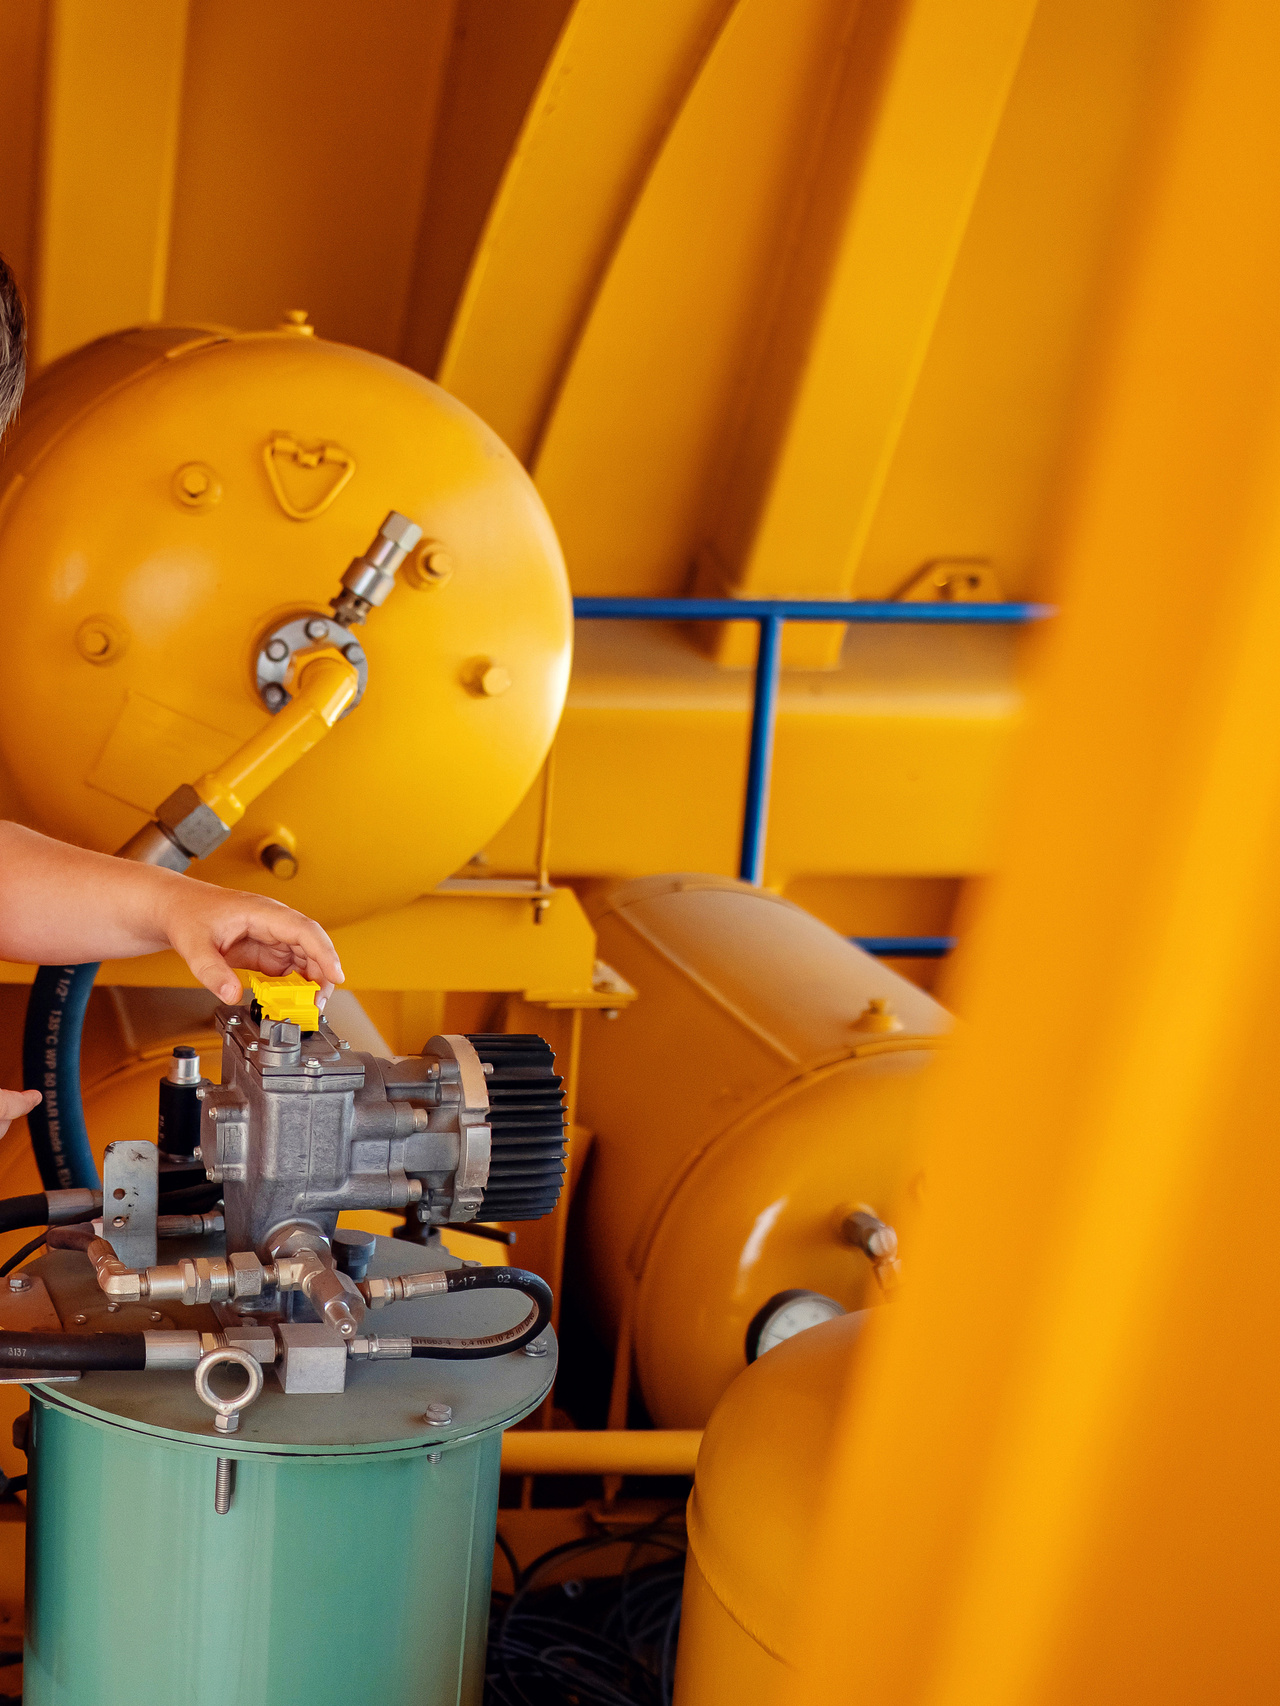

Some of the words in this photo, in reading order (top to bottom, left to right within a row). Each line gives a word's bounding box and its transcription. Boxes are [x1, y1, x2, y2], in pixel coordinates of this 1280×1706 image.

[46, 1048, 57, 1069] WP
[45, 1090, 58, 1118] BAR
[48, 1120, 61, 1152] Made
[55, 1154, 64, 1167] in
[477, 1337, 494, 1346] mm
[8, 1347, 27, 1357] 3137
